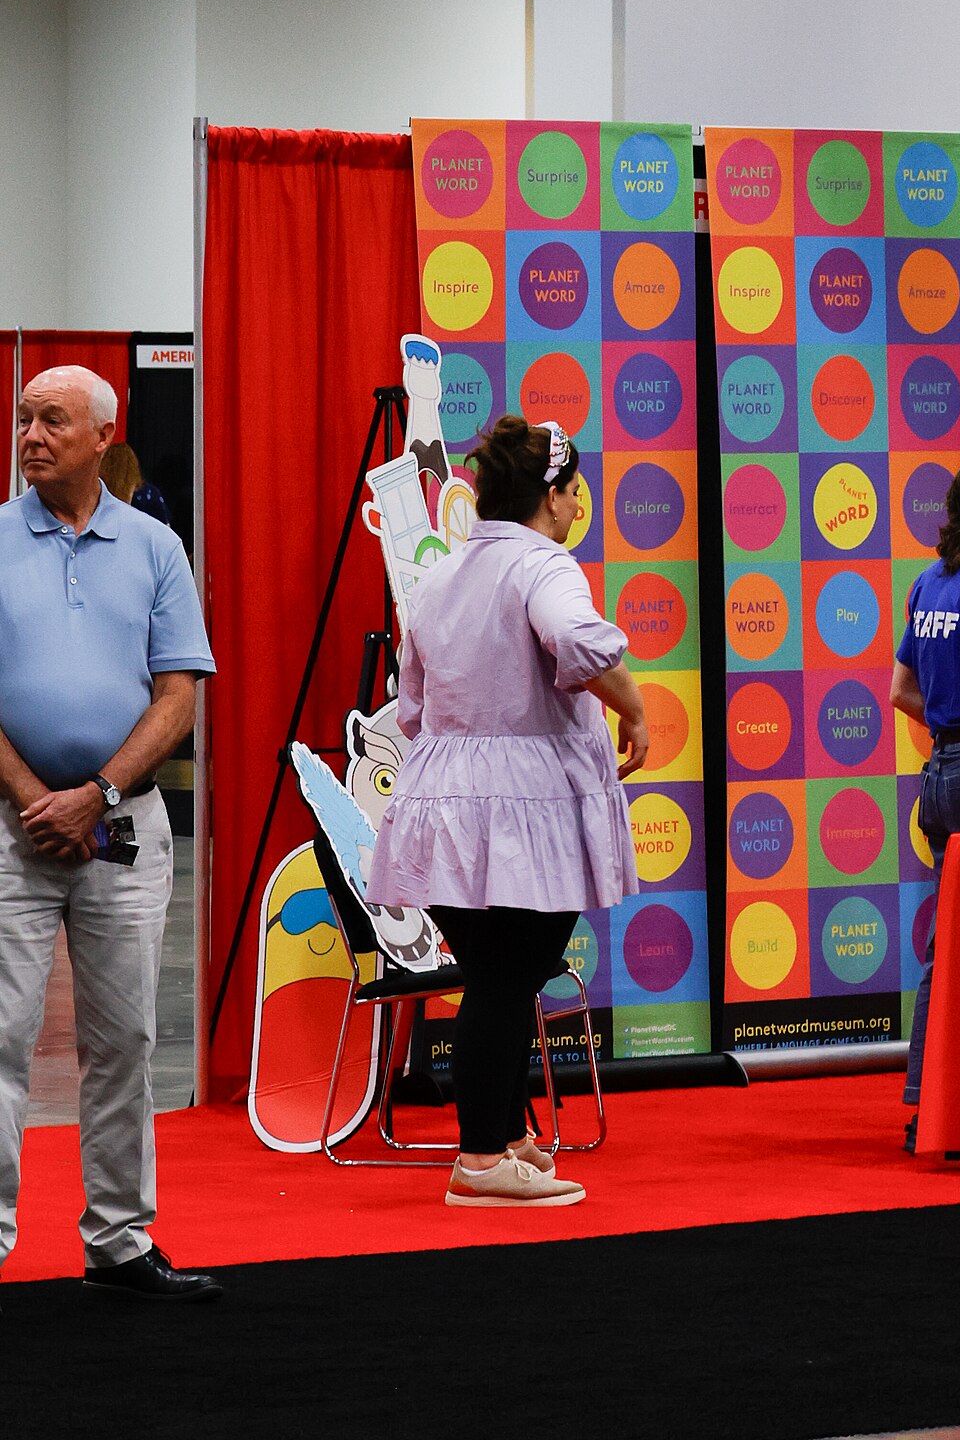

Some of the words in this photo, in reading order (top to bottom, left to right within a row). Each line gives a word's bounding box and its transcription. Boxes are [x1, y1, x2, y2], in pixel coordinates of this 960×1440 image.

[431, 158, 484, 172] PLANET
[620, 161, 669, 174] PLANET
[527, 169, 579, 186] Surprise
[725, 166, 774, 179] PLANET
[903, 169, 948, 182] PLANET
[435, 178, 479, 191] WORD
[624, 180, 665, 193] WORD
[730, 185, 771, 198] WORD
[815, 176, 863, 194] Surprise
[907, 188, 945, 201] WORD
[529, 269, 580, 283] PLANET
[819, 275, 863, 288] PLANET
[433, 280, 479, 297] Inspire
[624, 281, 665, 294] Amaze
[729, 285, 771, 301] Inspire
[908, 286, 946, 299] Amaze
[535, 289, 576, 303] WORD
[823, 294, 860, 307] WORD
[442, 381, 482, 395] ANET
[622, 380, 670, 393] PLANET
[728, 383, 775, 396] PLANET
[908, 382, 951, 395] PLANET
[529, 391, 582, 404] Discover
[819, 392, 867, 406] Discover
[627, 400, 665, 412] WORD
[732, 402, 771, 415] WORD
[913, 401, 947, 414] WORD
[838, 478, 868, 501] PLANET
[625, 500, 670, 517] Explore
[913, 498, 945, 517] Explor
[825, 504, 869, 532] WORD
[625, 599, 675, 614] PLANET
[731, 601, 779, 614] PLANET
[837, 608, 860, 625] Play
[629, 619, 669, 633] WORD
[736, 620, 775, 633] WORD
[914, 610, 960, 639] TAFF
[827, 707, 872, 720] PLANET
[736, 721, 778, 734] Create
[832, 726, 868, 739] WORD
[736, 818, 784, 833] PLANET
[826, 825, 877, 840] Immerse
[634, 840, 674, 854] WORD
[741, 838, 780, 852] WORD
[831, 922, 877, 938] PLANET
[747, 938, 778, 954] Build
[836, 942, 874, 957] WORD
[734, 1017, 891, 1041] planetwordmuseum.org
